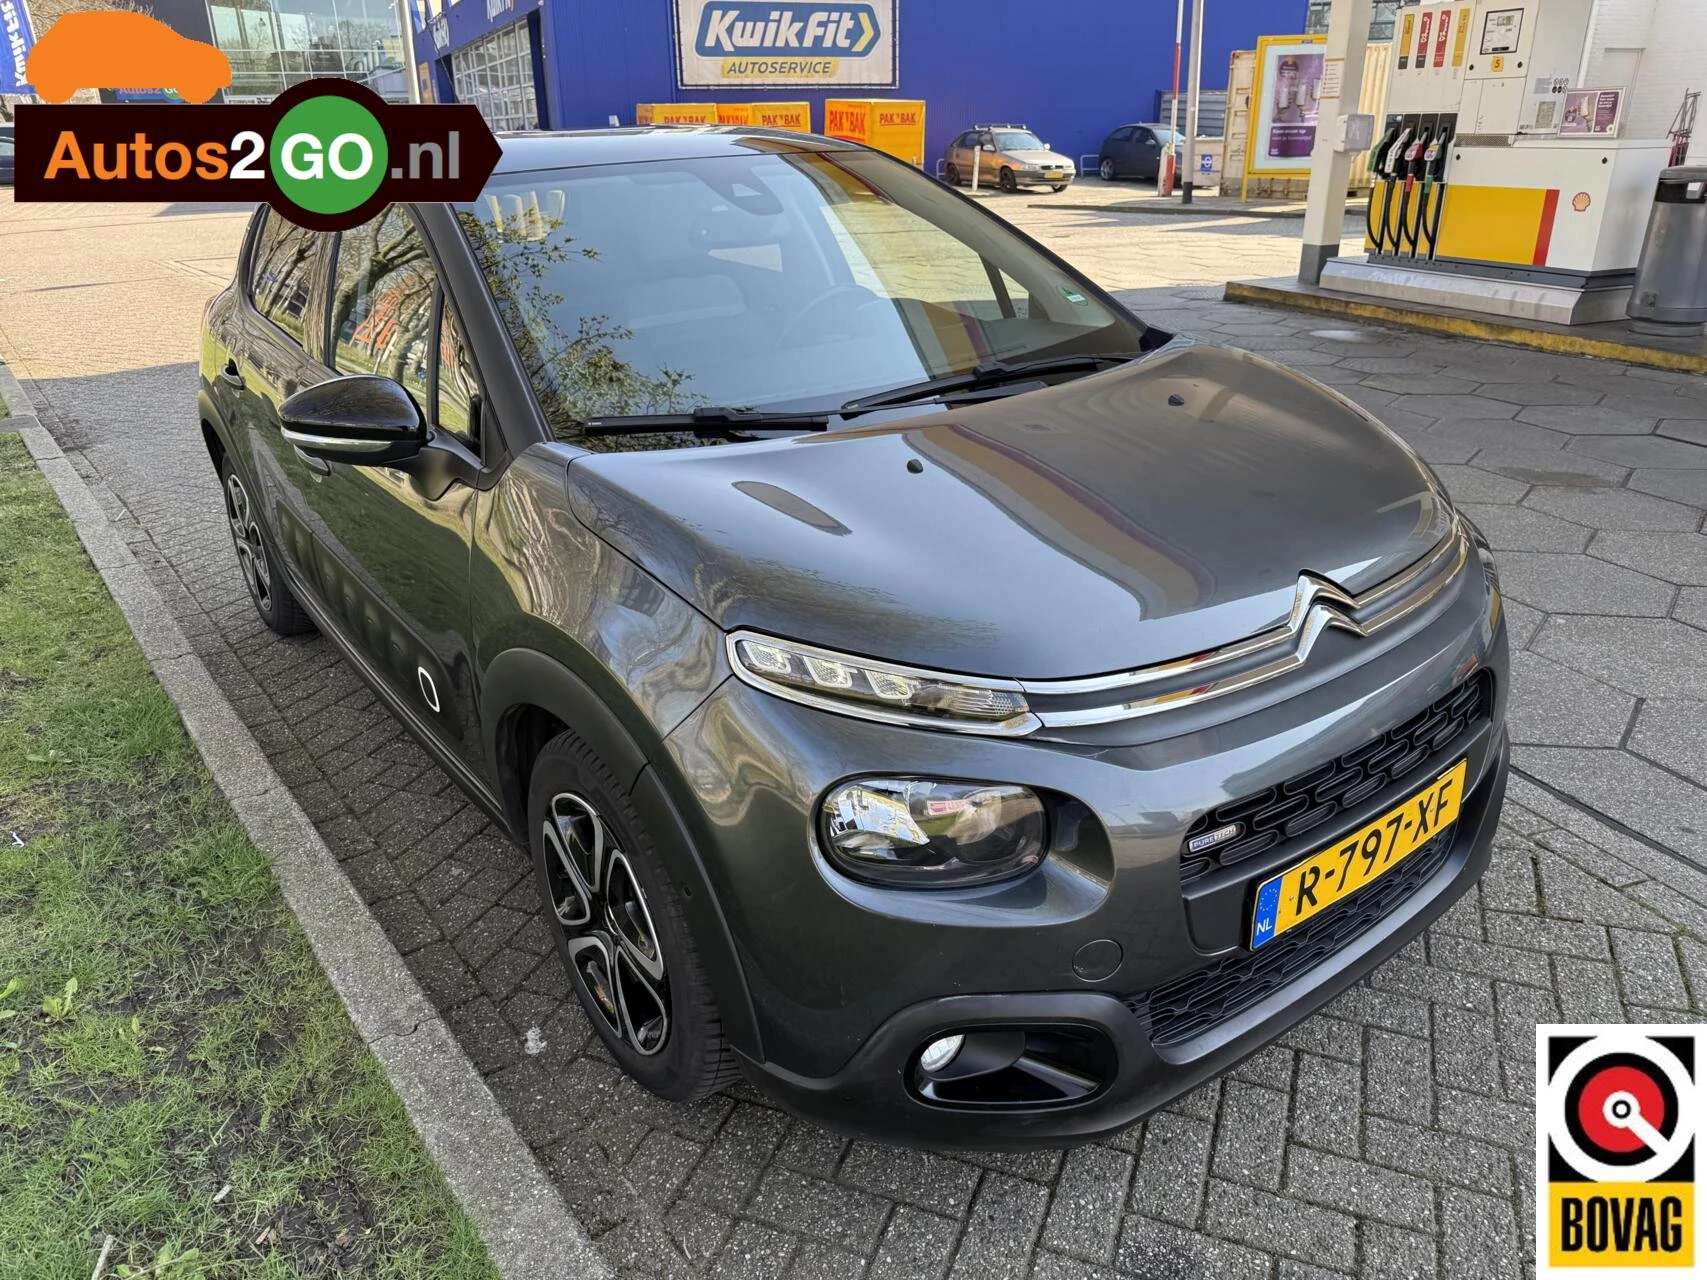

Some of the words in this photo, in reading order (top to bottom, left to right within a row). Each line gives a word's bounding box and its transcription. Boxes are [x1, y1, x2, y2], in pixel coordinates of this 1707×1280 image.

[727, 61, 832, 75] AUTOSERVICE
[761, 114, 778, 126] PAK
[784, 113, 801, 125] BAK
[1295, 778, 1454, 917] R-797-XF
[1256, 917, 1273, 936] NL
